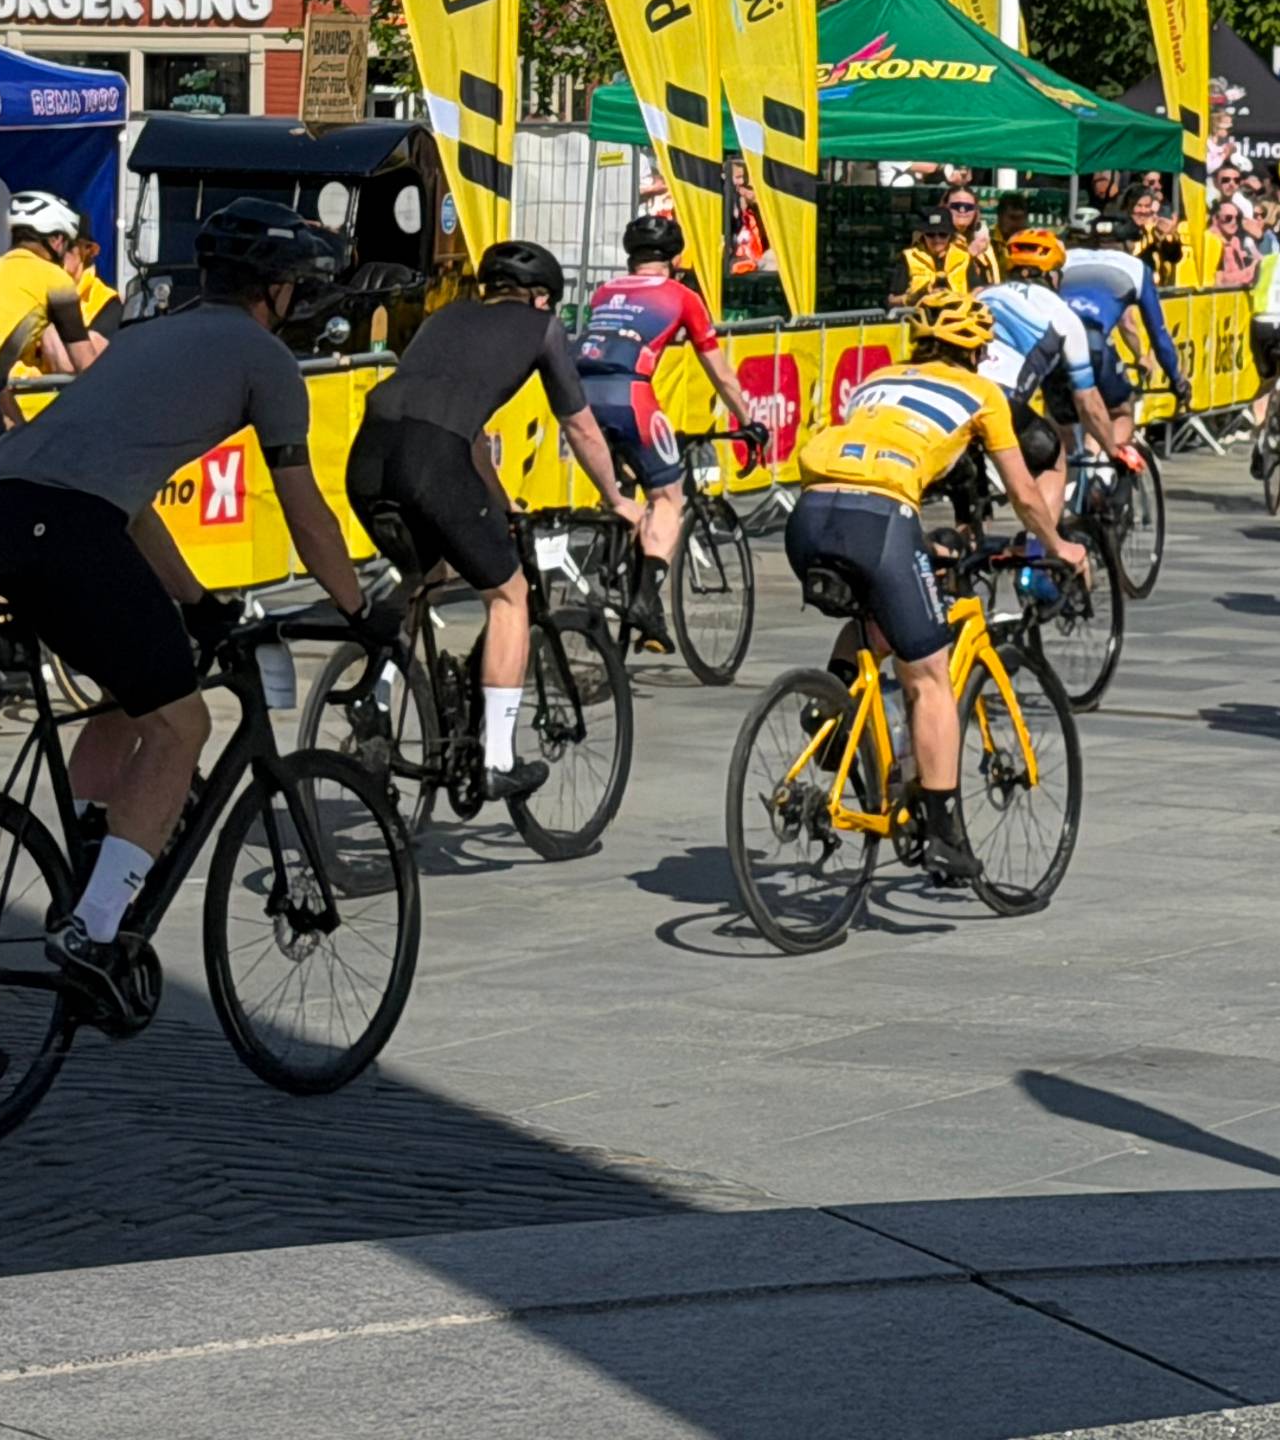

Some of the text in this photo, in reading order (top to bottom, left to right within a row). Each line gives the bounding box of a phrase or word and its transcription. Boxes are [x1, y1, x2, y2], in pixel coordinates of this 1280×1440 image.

[841, 58, 999, 84] KONDI
[30, 86, 120, 116] REMA 1000
[158, 450, 242, 521] no X
